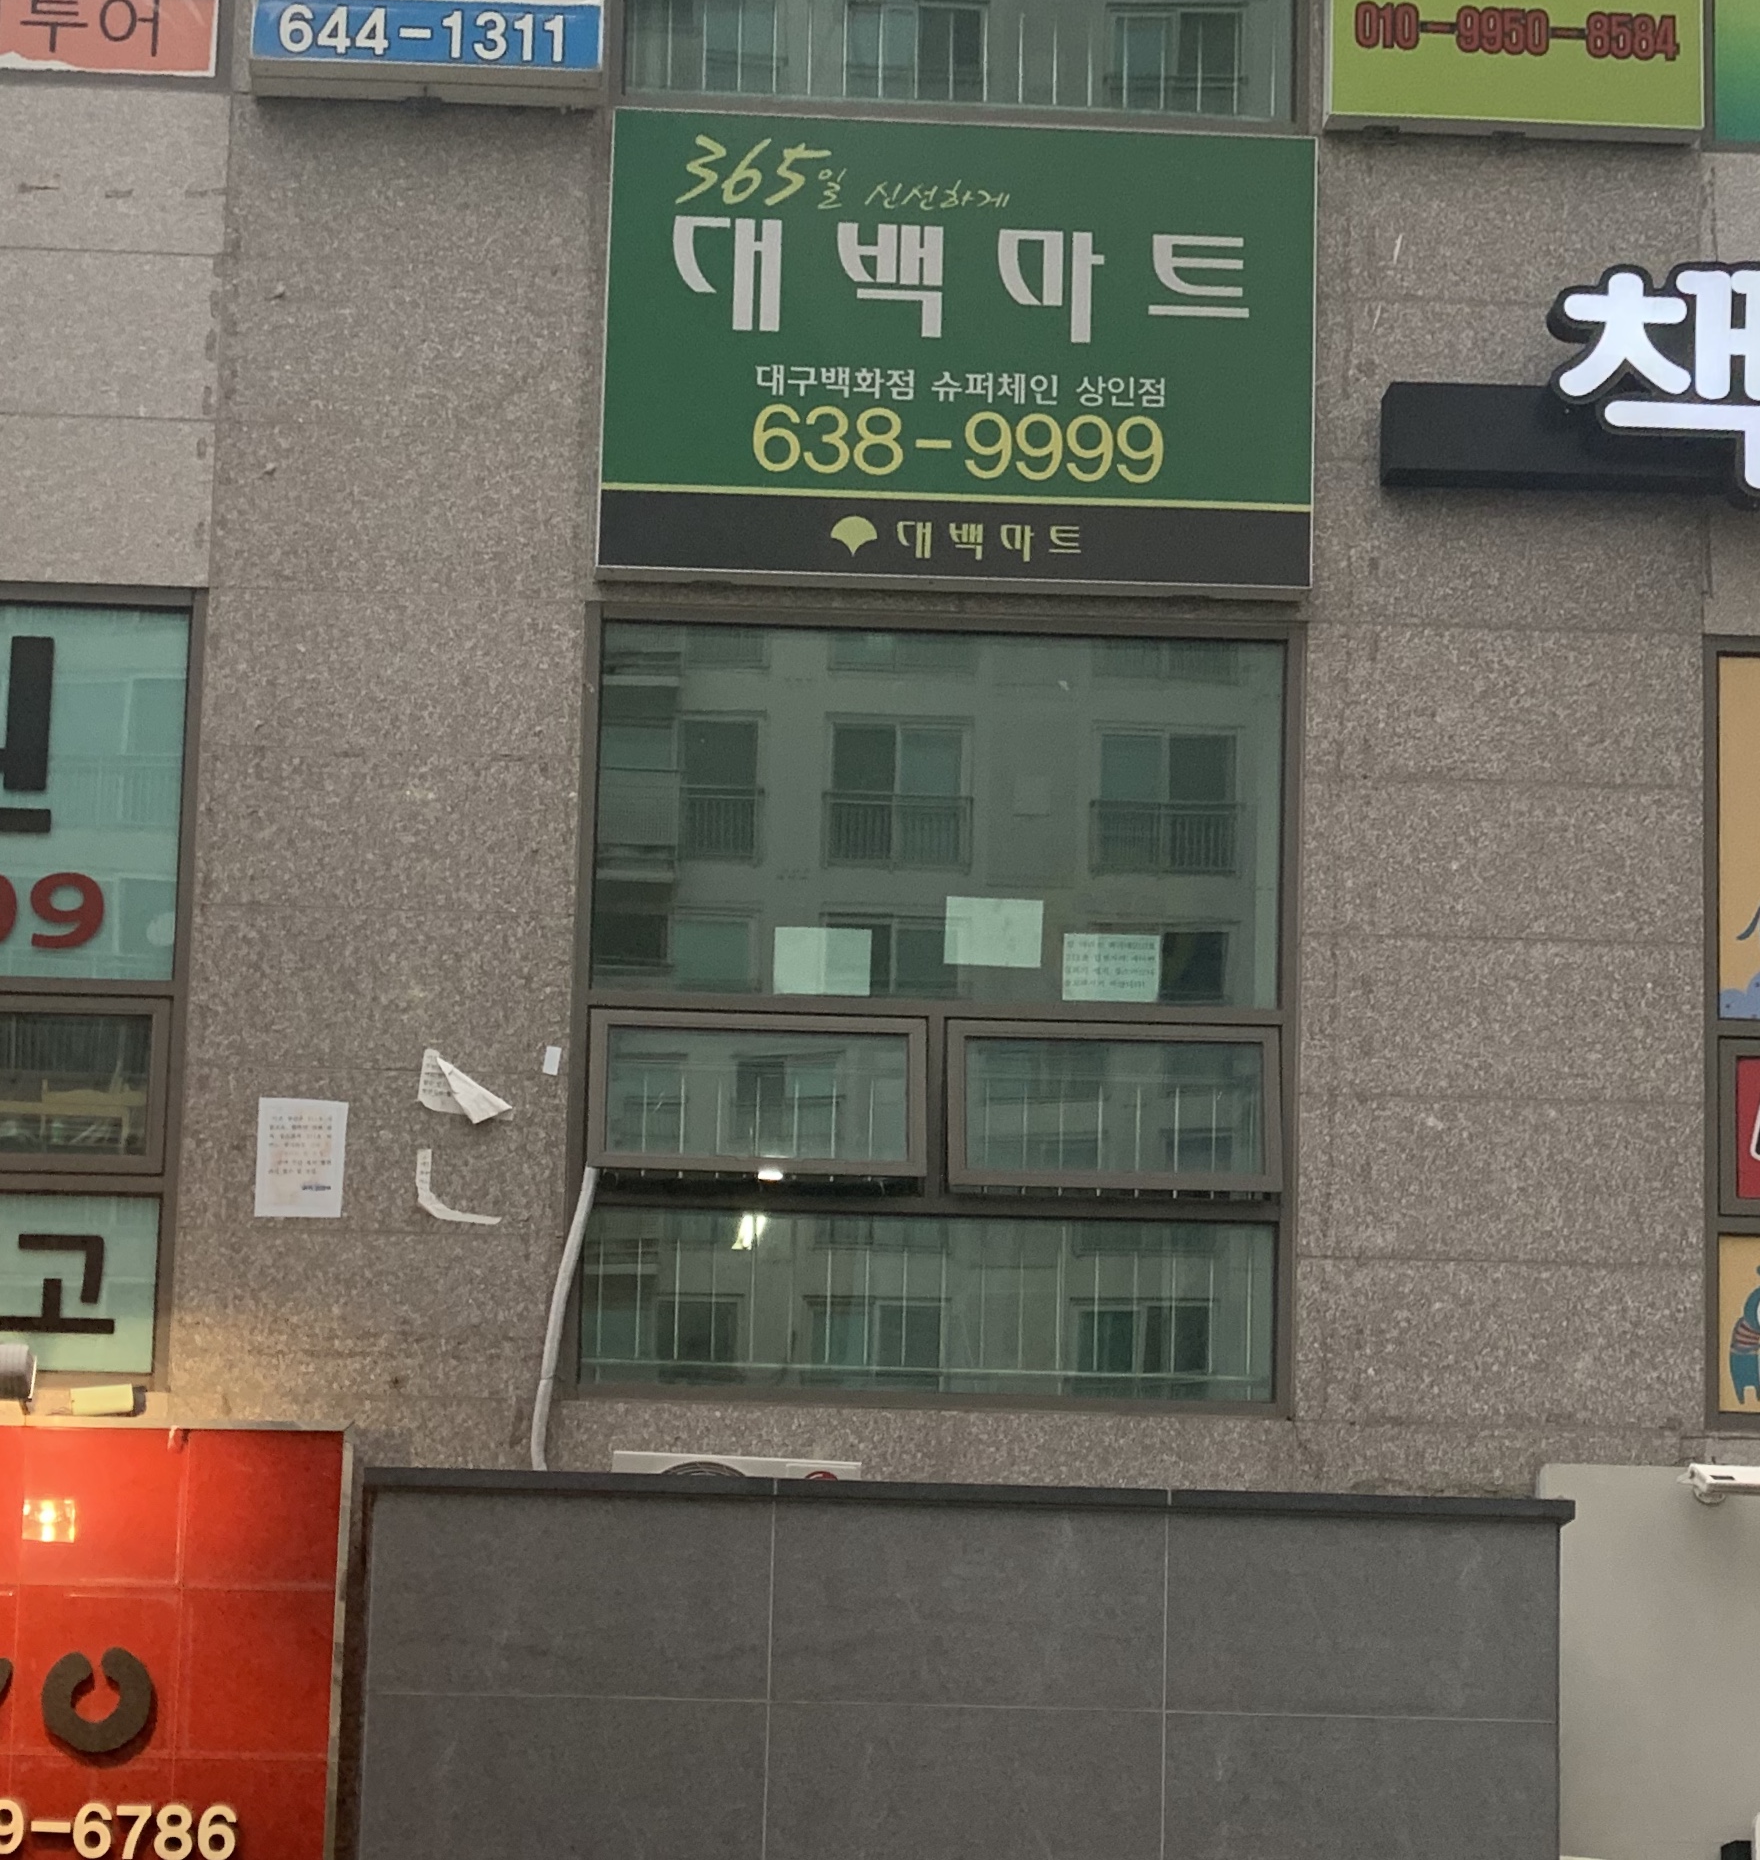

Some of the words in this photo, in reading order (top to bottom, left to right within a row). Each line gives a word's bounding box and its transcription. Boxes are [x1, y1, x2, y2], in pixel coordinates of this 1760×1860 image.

[278, 4, 565, 62] 644-1311
[1355, 1, 1680, 61] 010-9950-8584
[672, 214, 1251, 344] 대백마트
[756, 365, 916, 400] 대구백화점
[930, 368, 1059, 406] 슈퍼체인
[1075, 375, 1168, 408] 상인점
[752, 404, 1165, 485] 638-9999
[896, 519, 1082, 562] 대백마트
